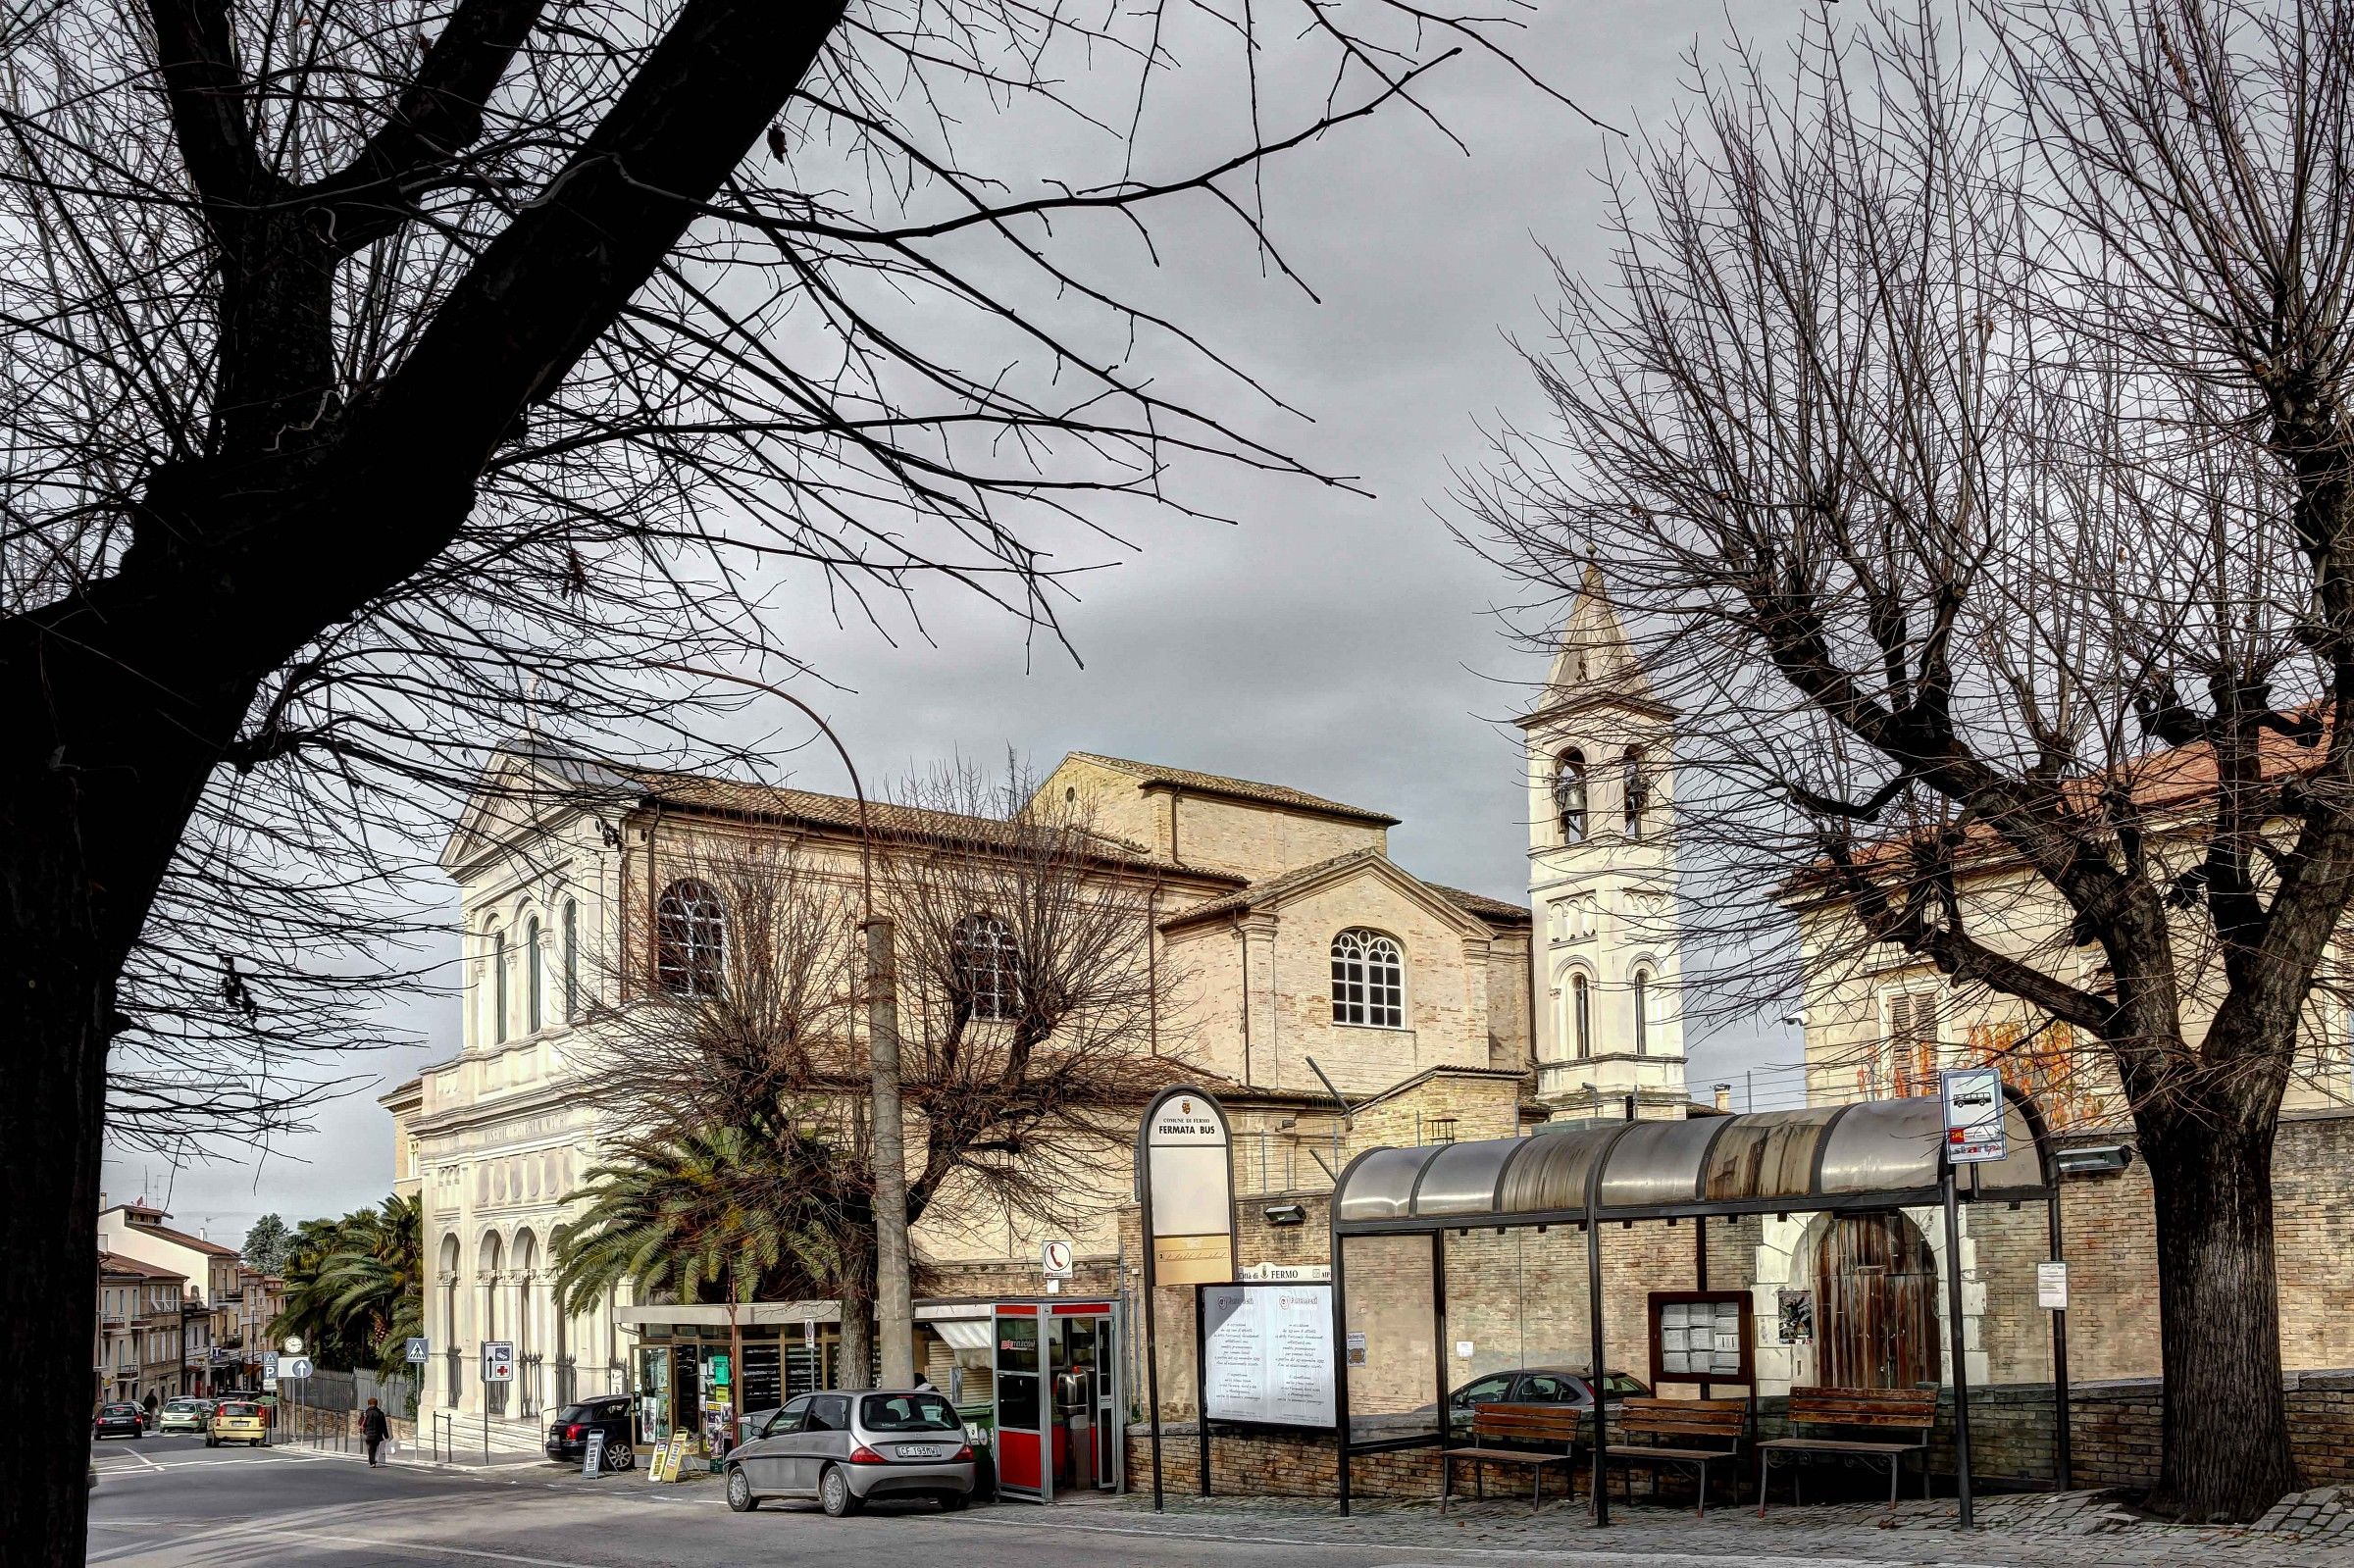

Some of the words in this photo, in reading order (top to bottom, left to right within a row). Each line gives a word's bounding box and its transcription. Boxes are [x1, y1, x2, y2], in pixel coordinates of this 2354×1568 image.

[1158, 1125, 1196, 1135] FERMATA
[1200, 1125, 1215, 1135] BUS
[1270, 1270, 1299, 1279] FERMO
[266, 1366, 275, 1378] P
